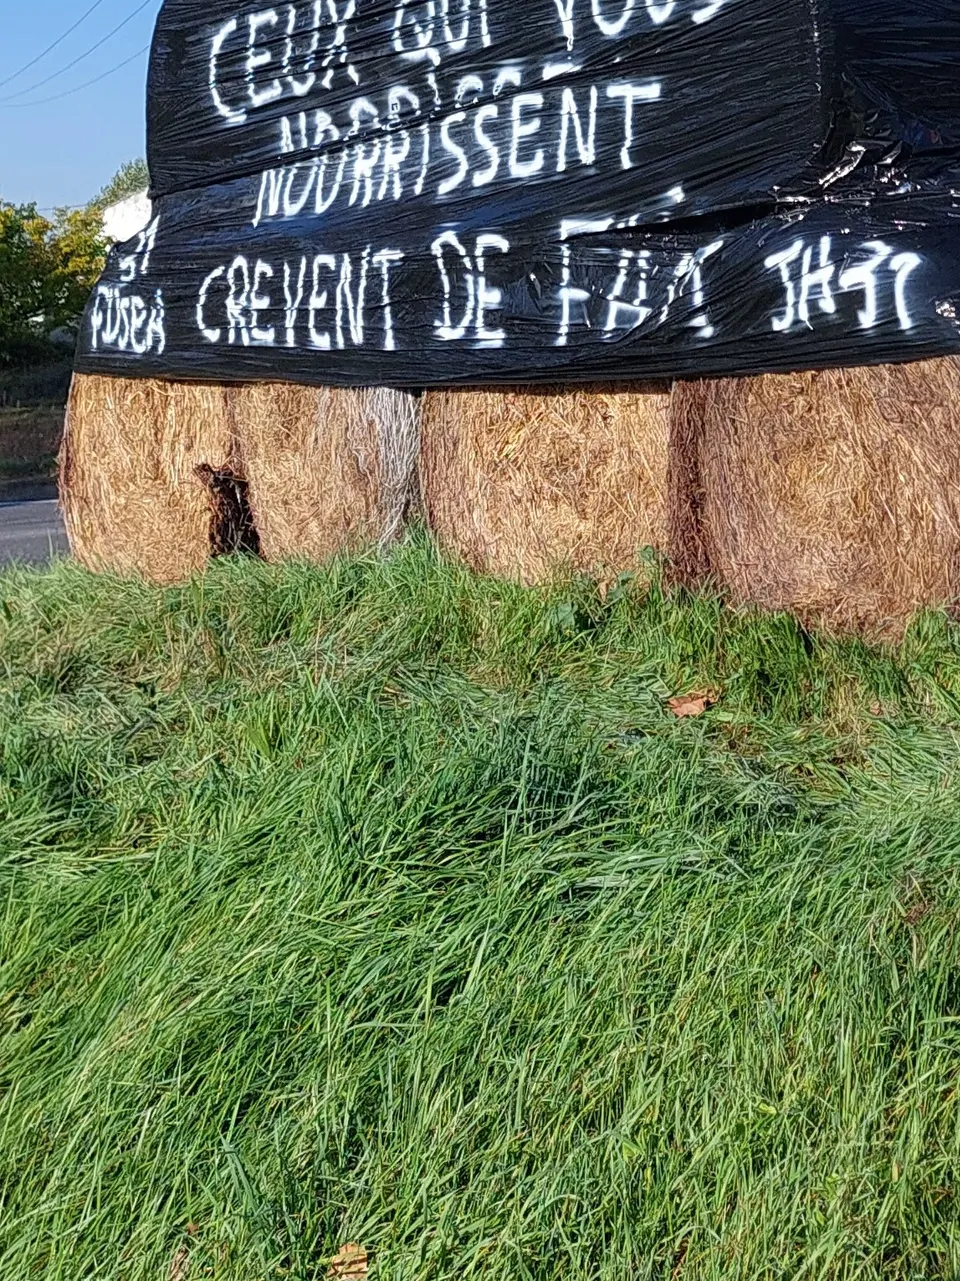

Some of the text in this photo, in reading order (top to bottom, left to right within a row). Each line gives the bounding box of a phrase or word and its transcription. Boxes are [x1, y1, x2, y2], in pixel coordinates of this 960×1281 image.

[252, 60, 662, 228] NOURRISSENT
[196, 245, 405, 350] CREVENT
[431, 222, 510, 350] DE
